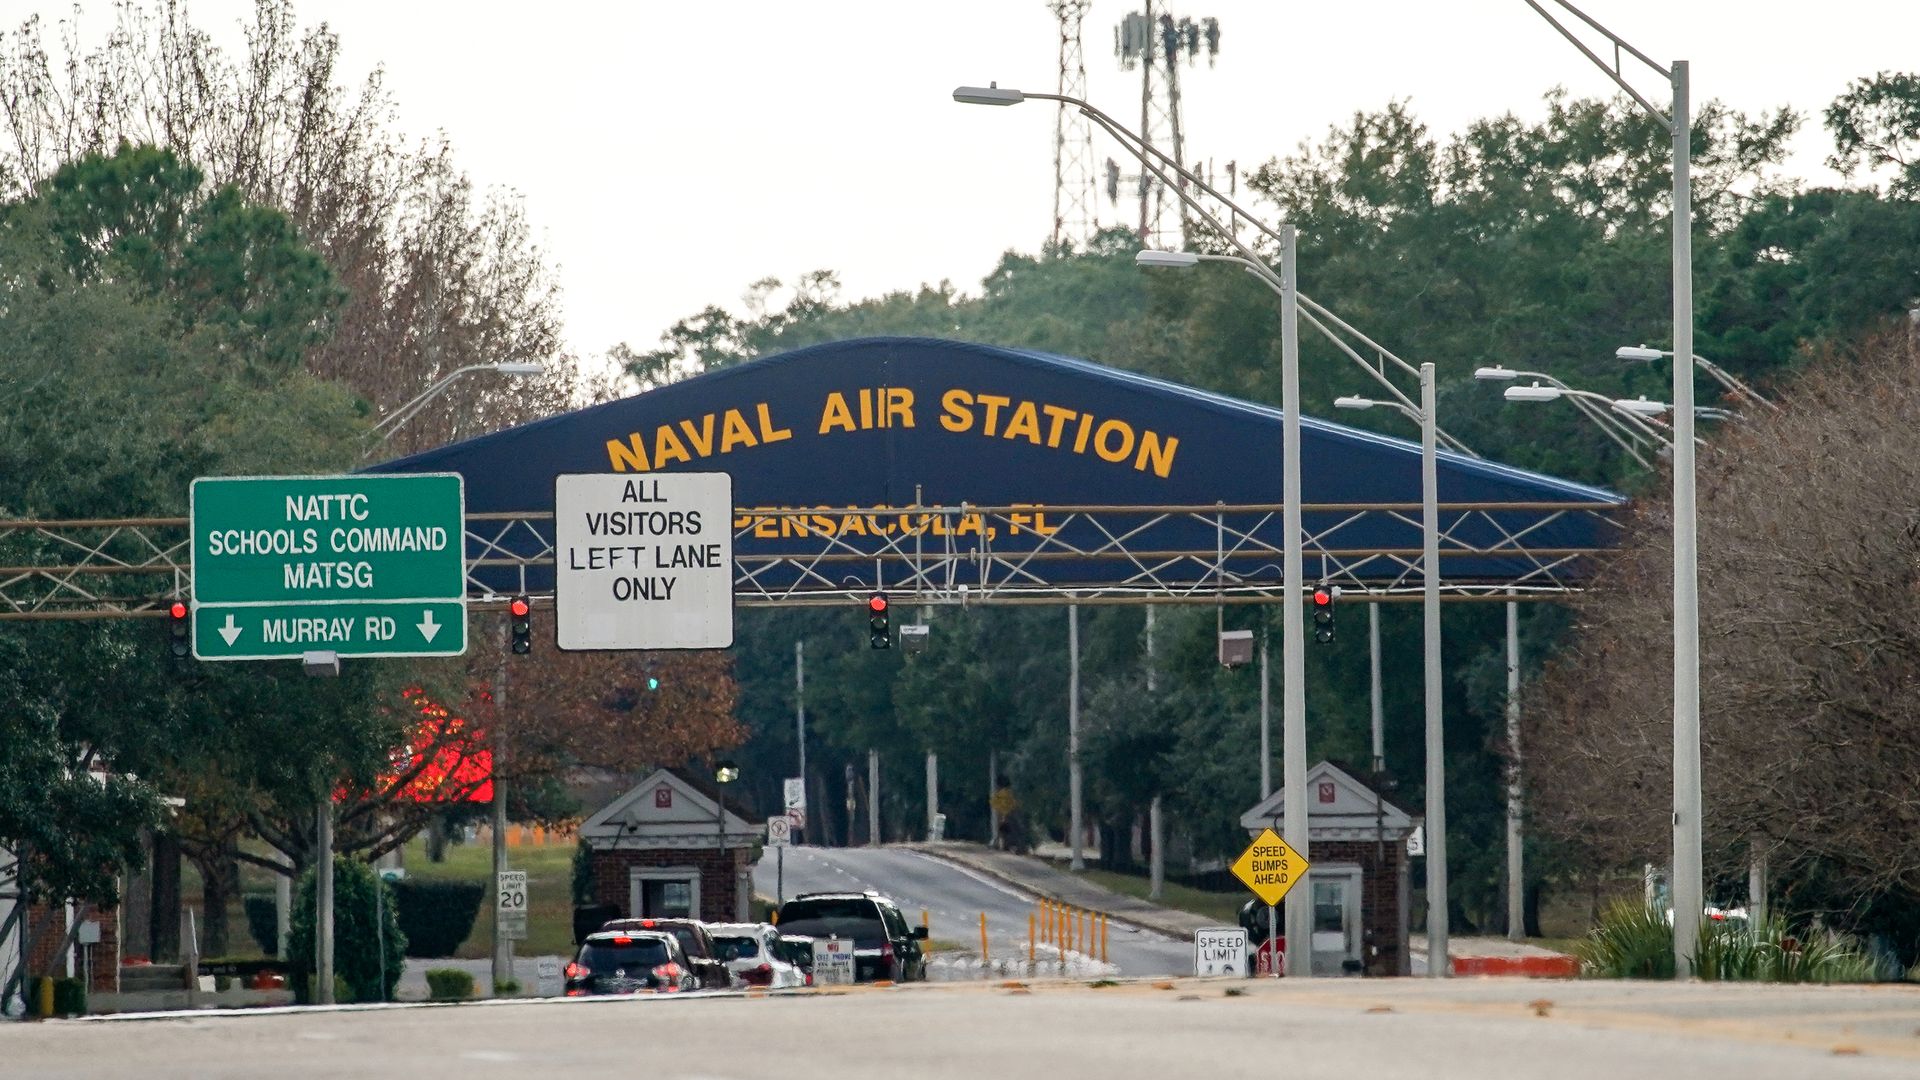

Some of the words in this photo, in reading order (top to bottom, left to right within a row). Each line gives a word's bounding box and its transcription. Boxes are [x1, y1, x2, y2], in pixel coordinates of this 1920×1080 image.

[605, 402, 793, 472] NAVAL
[818, 387, 916, 435] AIR
[939, 387, 1180, 479] STATION
[622, 480, 668, 503] ALL
[286, 493, 369, 521] NATTC
[1010, 503, 1060, 535] FL
[586, 510, 702, 536] VISITORS
[208, 528, 317, 556] SCHOOLS
[330, 527, 447, 553] COMMAND
[570, 546, 645, 570] LEFT
[655, 544, 722, 569] LANE
[284, 561, 373, 589] MATSG
[612, 576, 677, 601] ONLY
[263, 617, 355, 643] MURRAY
[365, 616, 396, 641] RD
[1252, 846, 1286, 858] SPEED
[1252, 859, 1289, 872] BUMPS
[500, 874, 525, 882] SPEED
[502, 883, 522, 891] LIMIT
[1254, 873, 1288, 885] AHEAD
[500, 891, 524, 908] 20
[1199, 937, 1244, 948] SPEED
[1203, 949, 1238, 961] LIMIT
